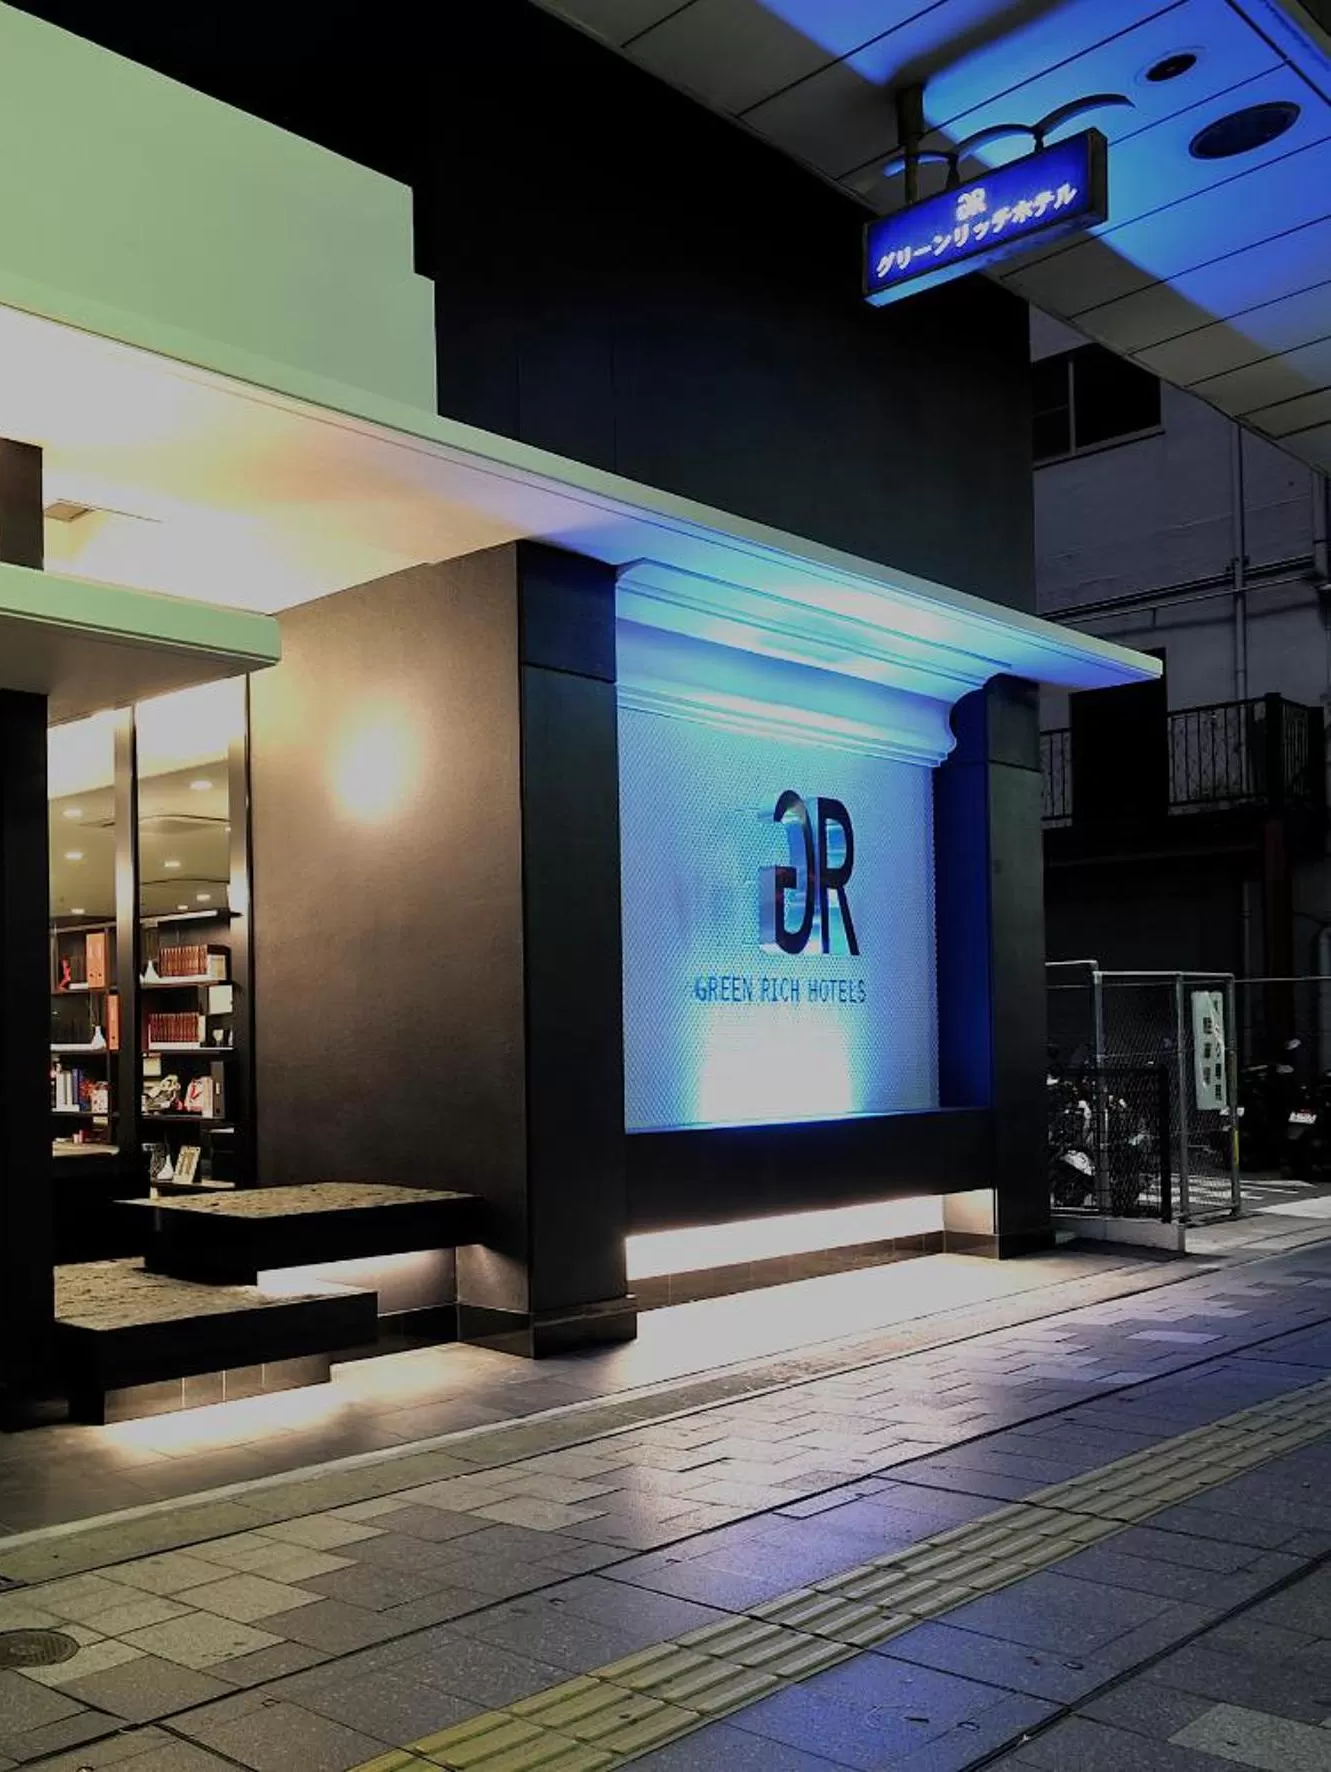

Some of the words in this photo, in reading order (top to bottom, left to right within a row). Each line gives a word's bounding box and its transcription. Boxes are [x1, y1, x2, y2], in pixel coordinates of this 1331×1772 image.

[876, 182, 1078, 278] グリーンリッチホテル
[695, 975, 753, 1002] GREEN
[762, 977, 800, 1003] RICH
[808, 979, 867, 1004] HOTELS
